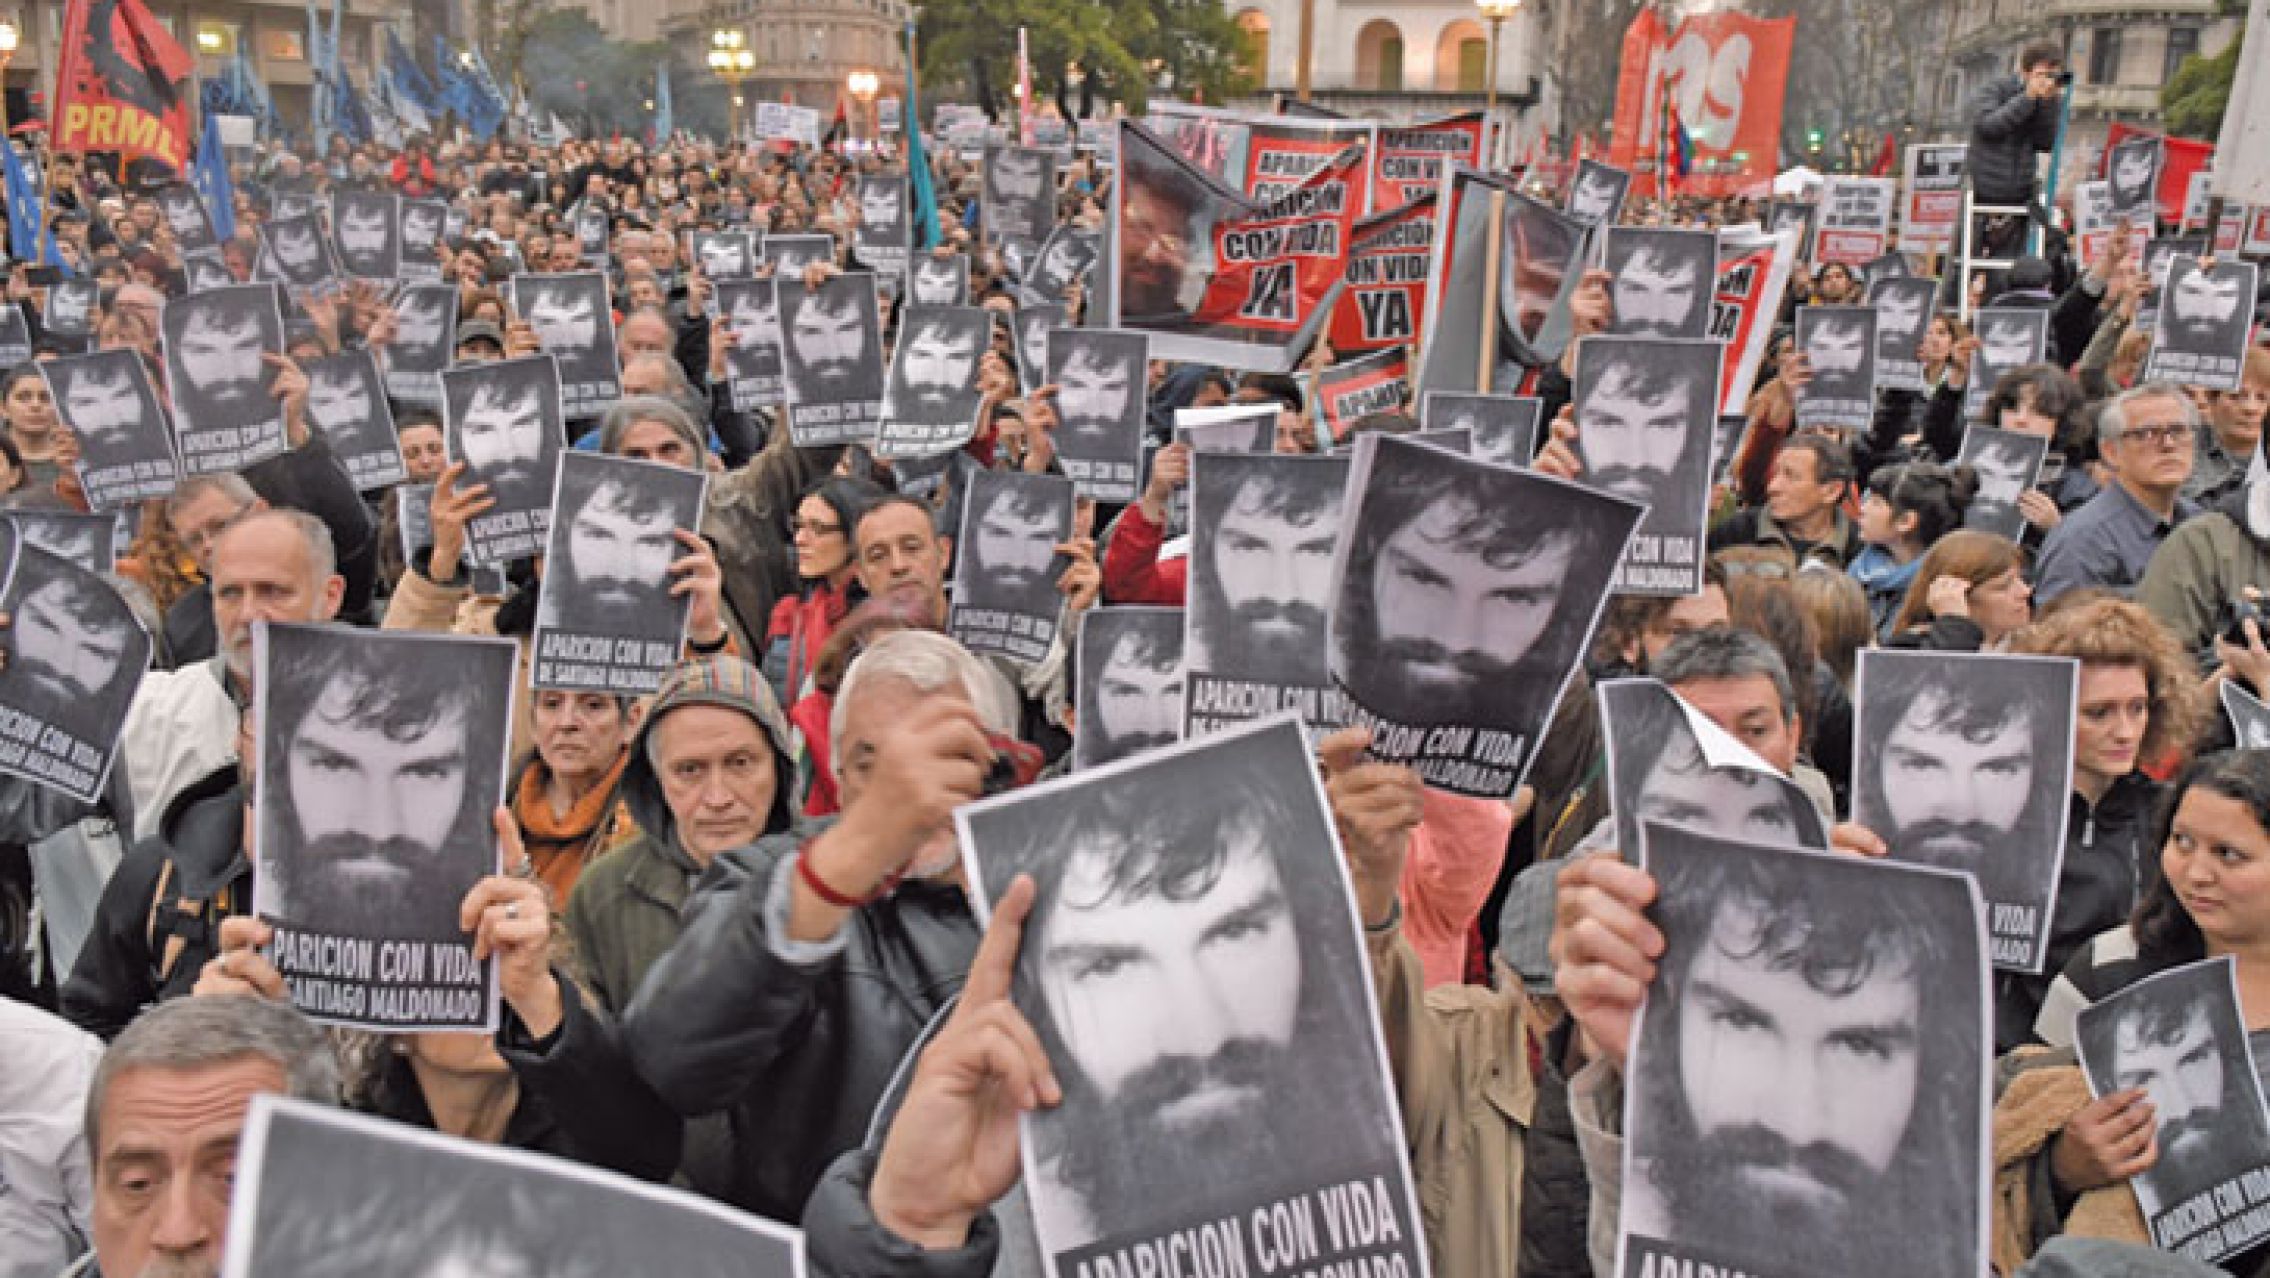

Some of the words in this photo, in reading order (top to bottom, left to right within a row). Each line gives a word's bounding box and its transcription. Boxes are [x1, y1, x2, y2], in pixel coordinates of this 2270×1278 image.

[63, 103, 178, 168] PRML
[1241, 262, 1295, 318] YA
[1346, 258, 1377, 284] ON
[1359, 292, 1413, 338] YA
[1424, 724, 1474, 757] CON
[1473, 728, 1525, 767] VIDA
[274, 928, 373, 981] PARICION
[379, 940, 425, 983] CON
[432, 942, 482, 985] VIDA
[370, 985, 482, 1021] MALDONADO
[1077, 1215, 1249, 1278] RICION
[1251, 1194, 1318, 1273] CON
[1317, 1176, 1401, 1252] VIDA
